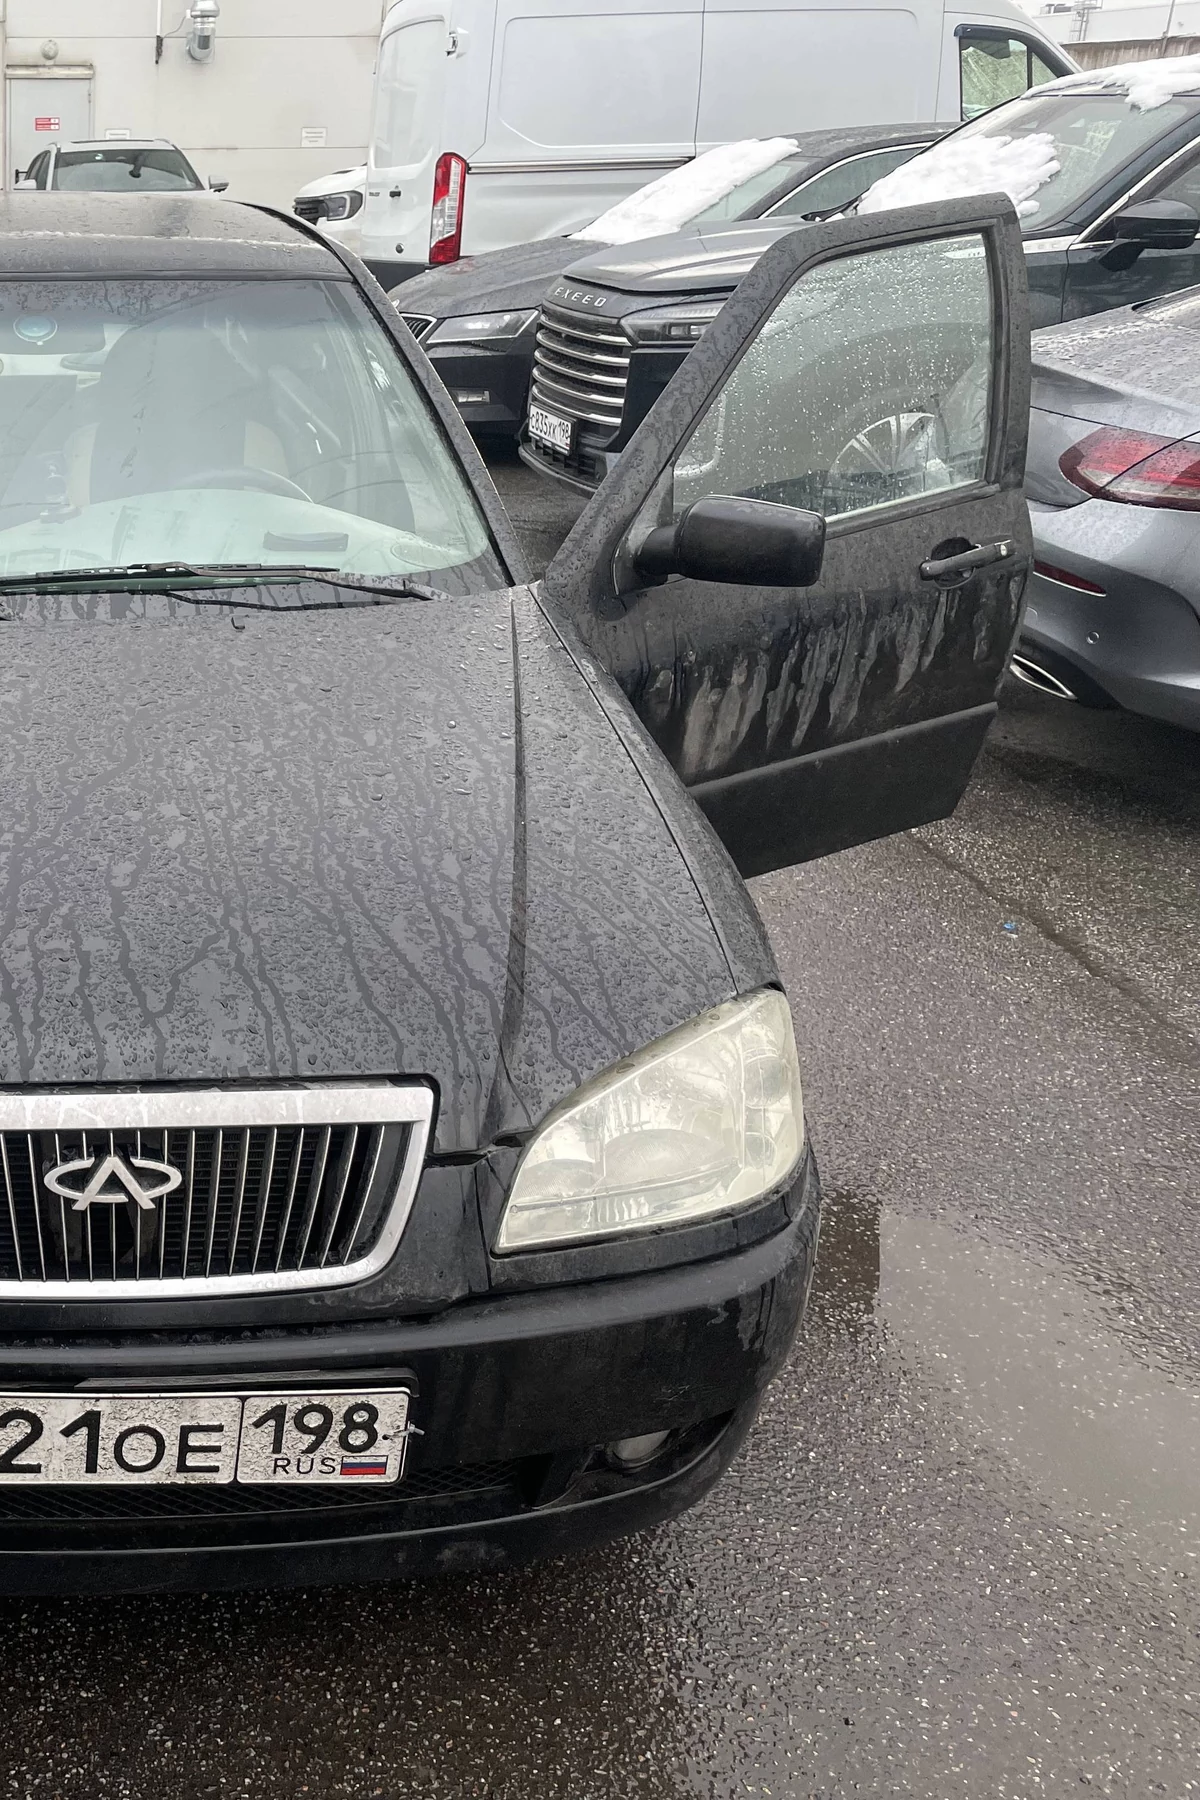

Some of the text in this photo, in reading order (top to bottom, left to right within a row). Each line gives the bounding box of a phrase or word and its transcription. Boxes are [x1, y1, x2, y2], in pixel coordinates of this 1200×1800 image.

[554, 287, 607, 307] EXEED
[252, 1402, 380, 1455] 198
[272, 1456, 337, 1475] RUS
